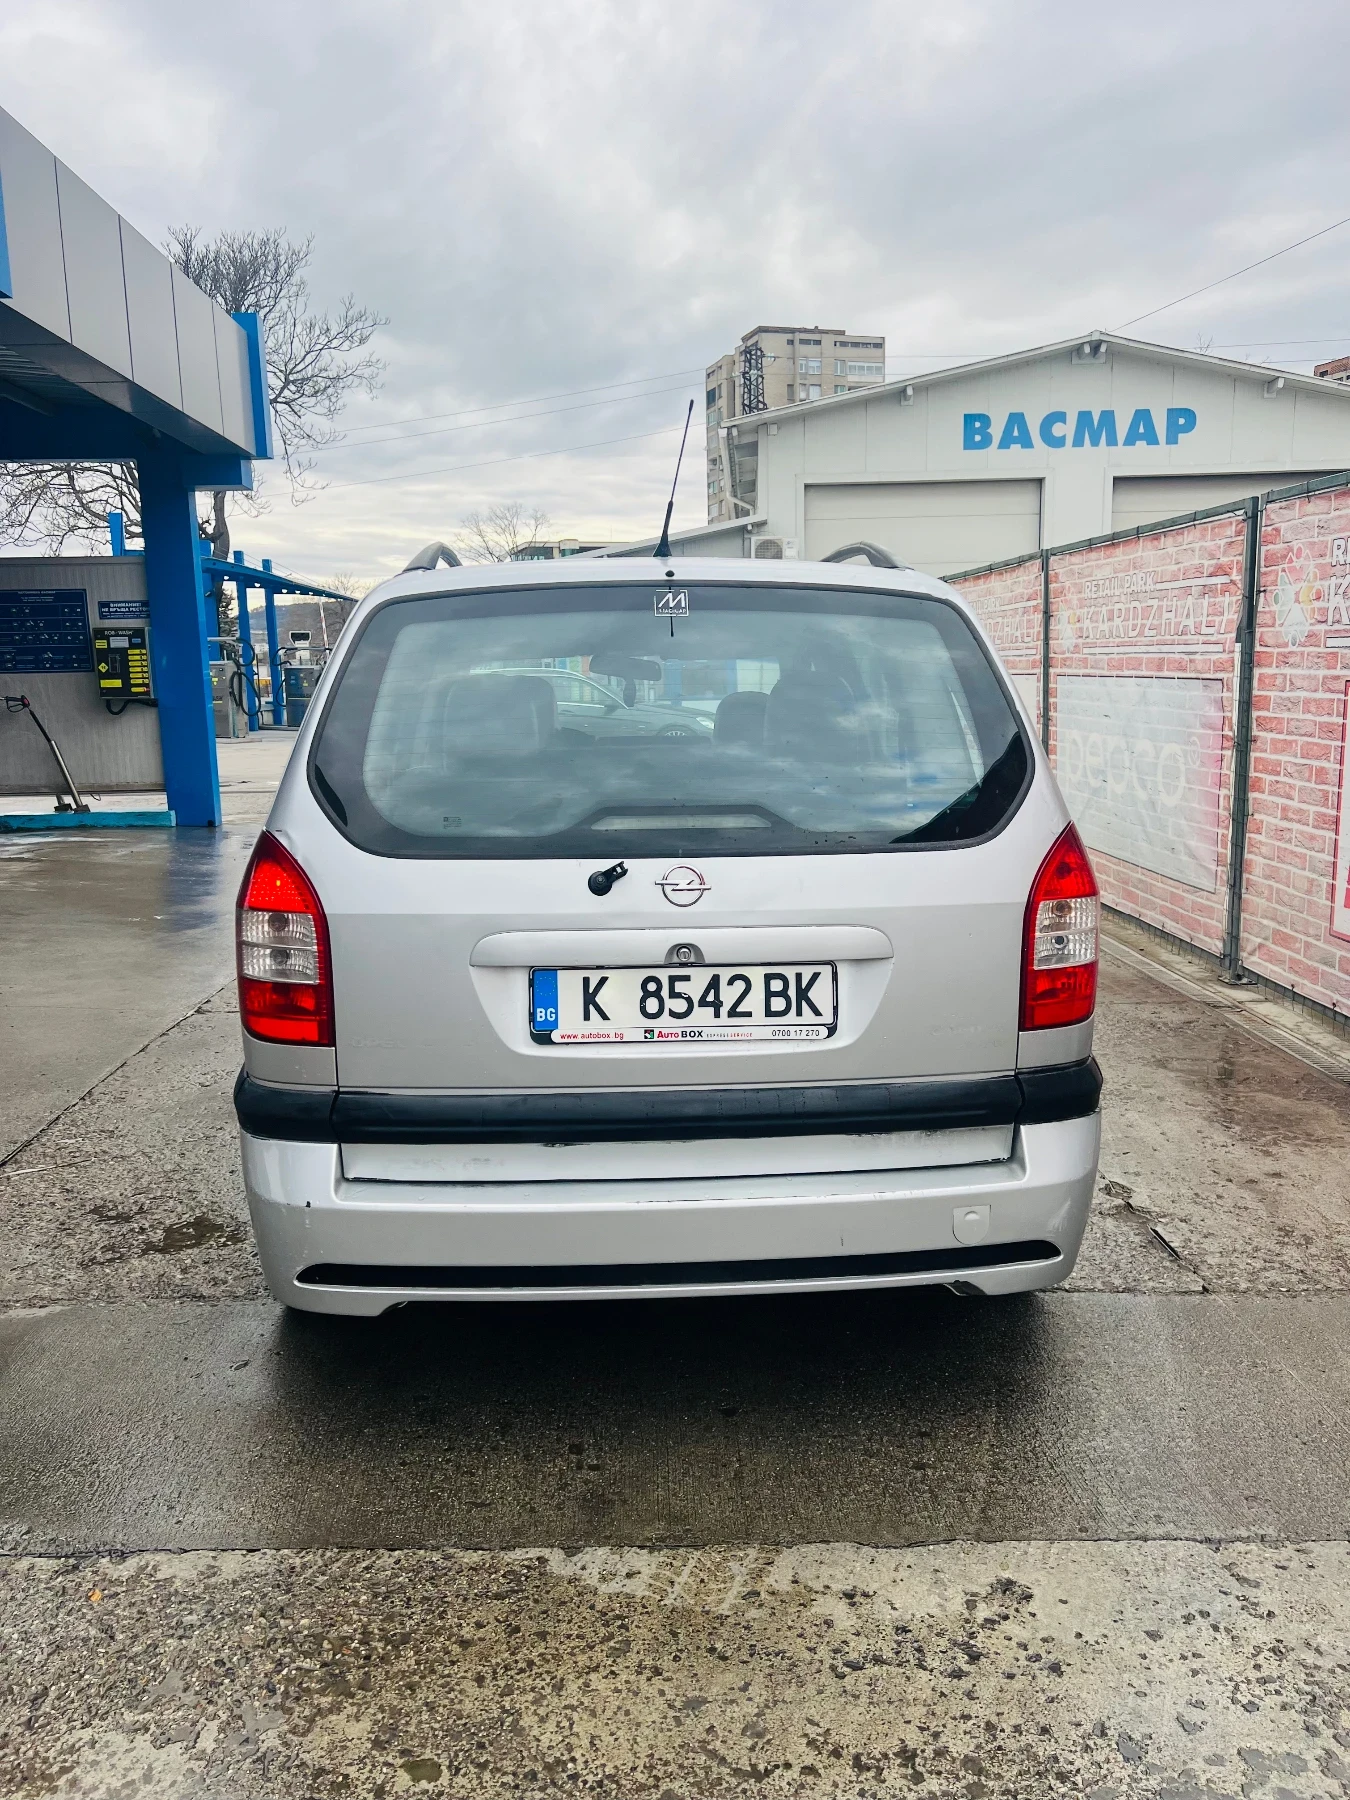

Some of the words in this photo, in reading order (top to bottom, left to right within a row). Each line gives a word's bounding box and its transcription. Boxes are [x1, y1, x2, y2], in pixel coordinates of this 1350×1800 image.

[1084, 573, 1120, 600] RETAIL
[1124, 570, 1157, 594] PARK
[1083, 591, 1230, 640] KARDZHALI
[1065, 729, 1186, 808] pepco
[536, 1008, 556, 1023] BG
[582, 975, 611, 1022] K
[639, 973, 754, 1020] 8542
[764, 971, 823, 1018] BK
[559, 1031, 625, 1041] www.autobox.bg
[772, 1029, 791, 1037] 0700
[795, 1029, 803, 1037] 17
[805, 1029, 820, 1037] 270
